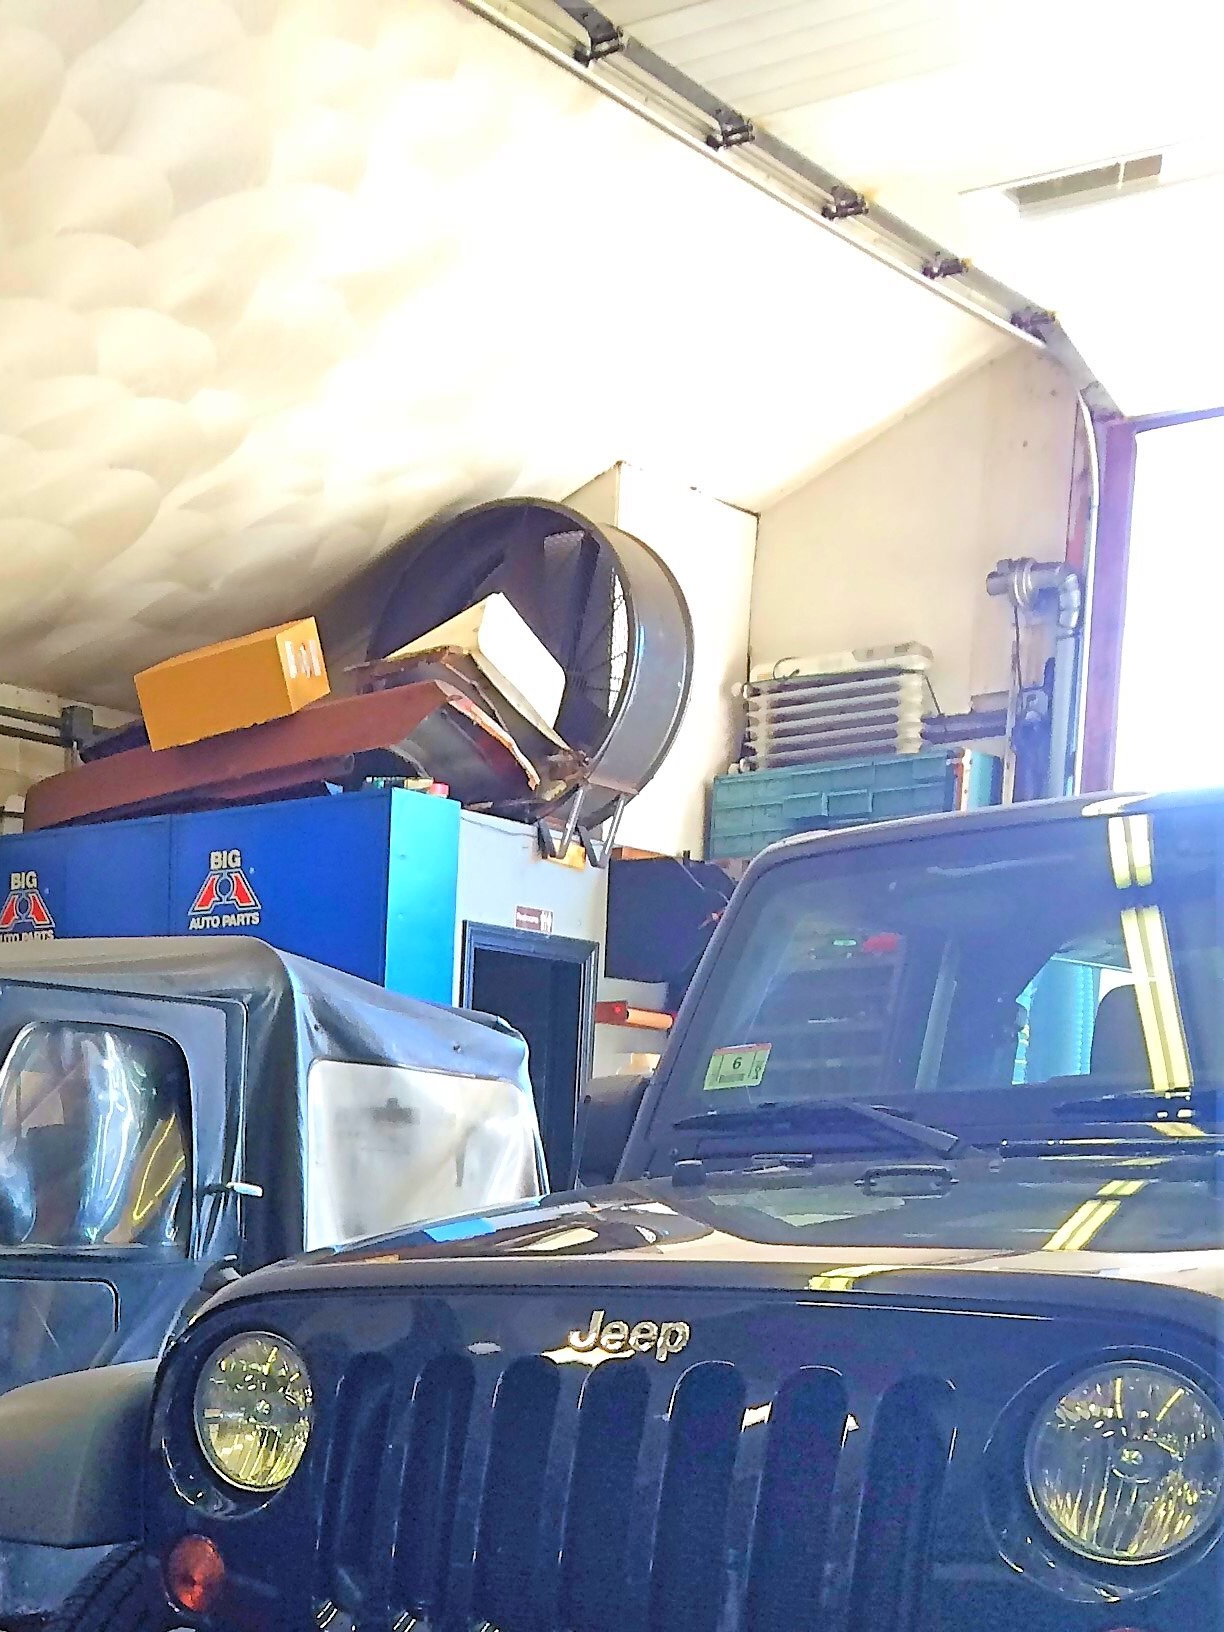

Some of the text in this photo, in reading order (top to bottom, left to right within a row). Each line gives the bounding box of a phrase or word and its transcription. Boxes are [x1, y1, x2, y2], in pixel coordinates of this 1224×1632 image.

[210, 849, 241, 871] BIG
[10, 870, 38, 891] BIG
[189, 911, 260, 931] AUTO PARTS
[732, 1056, 743, 1070] 6
[567, 1308, 691, 1364] Jeep
